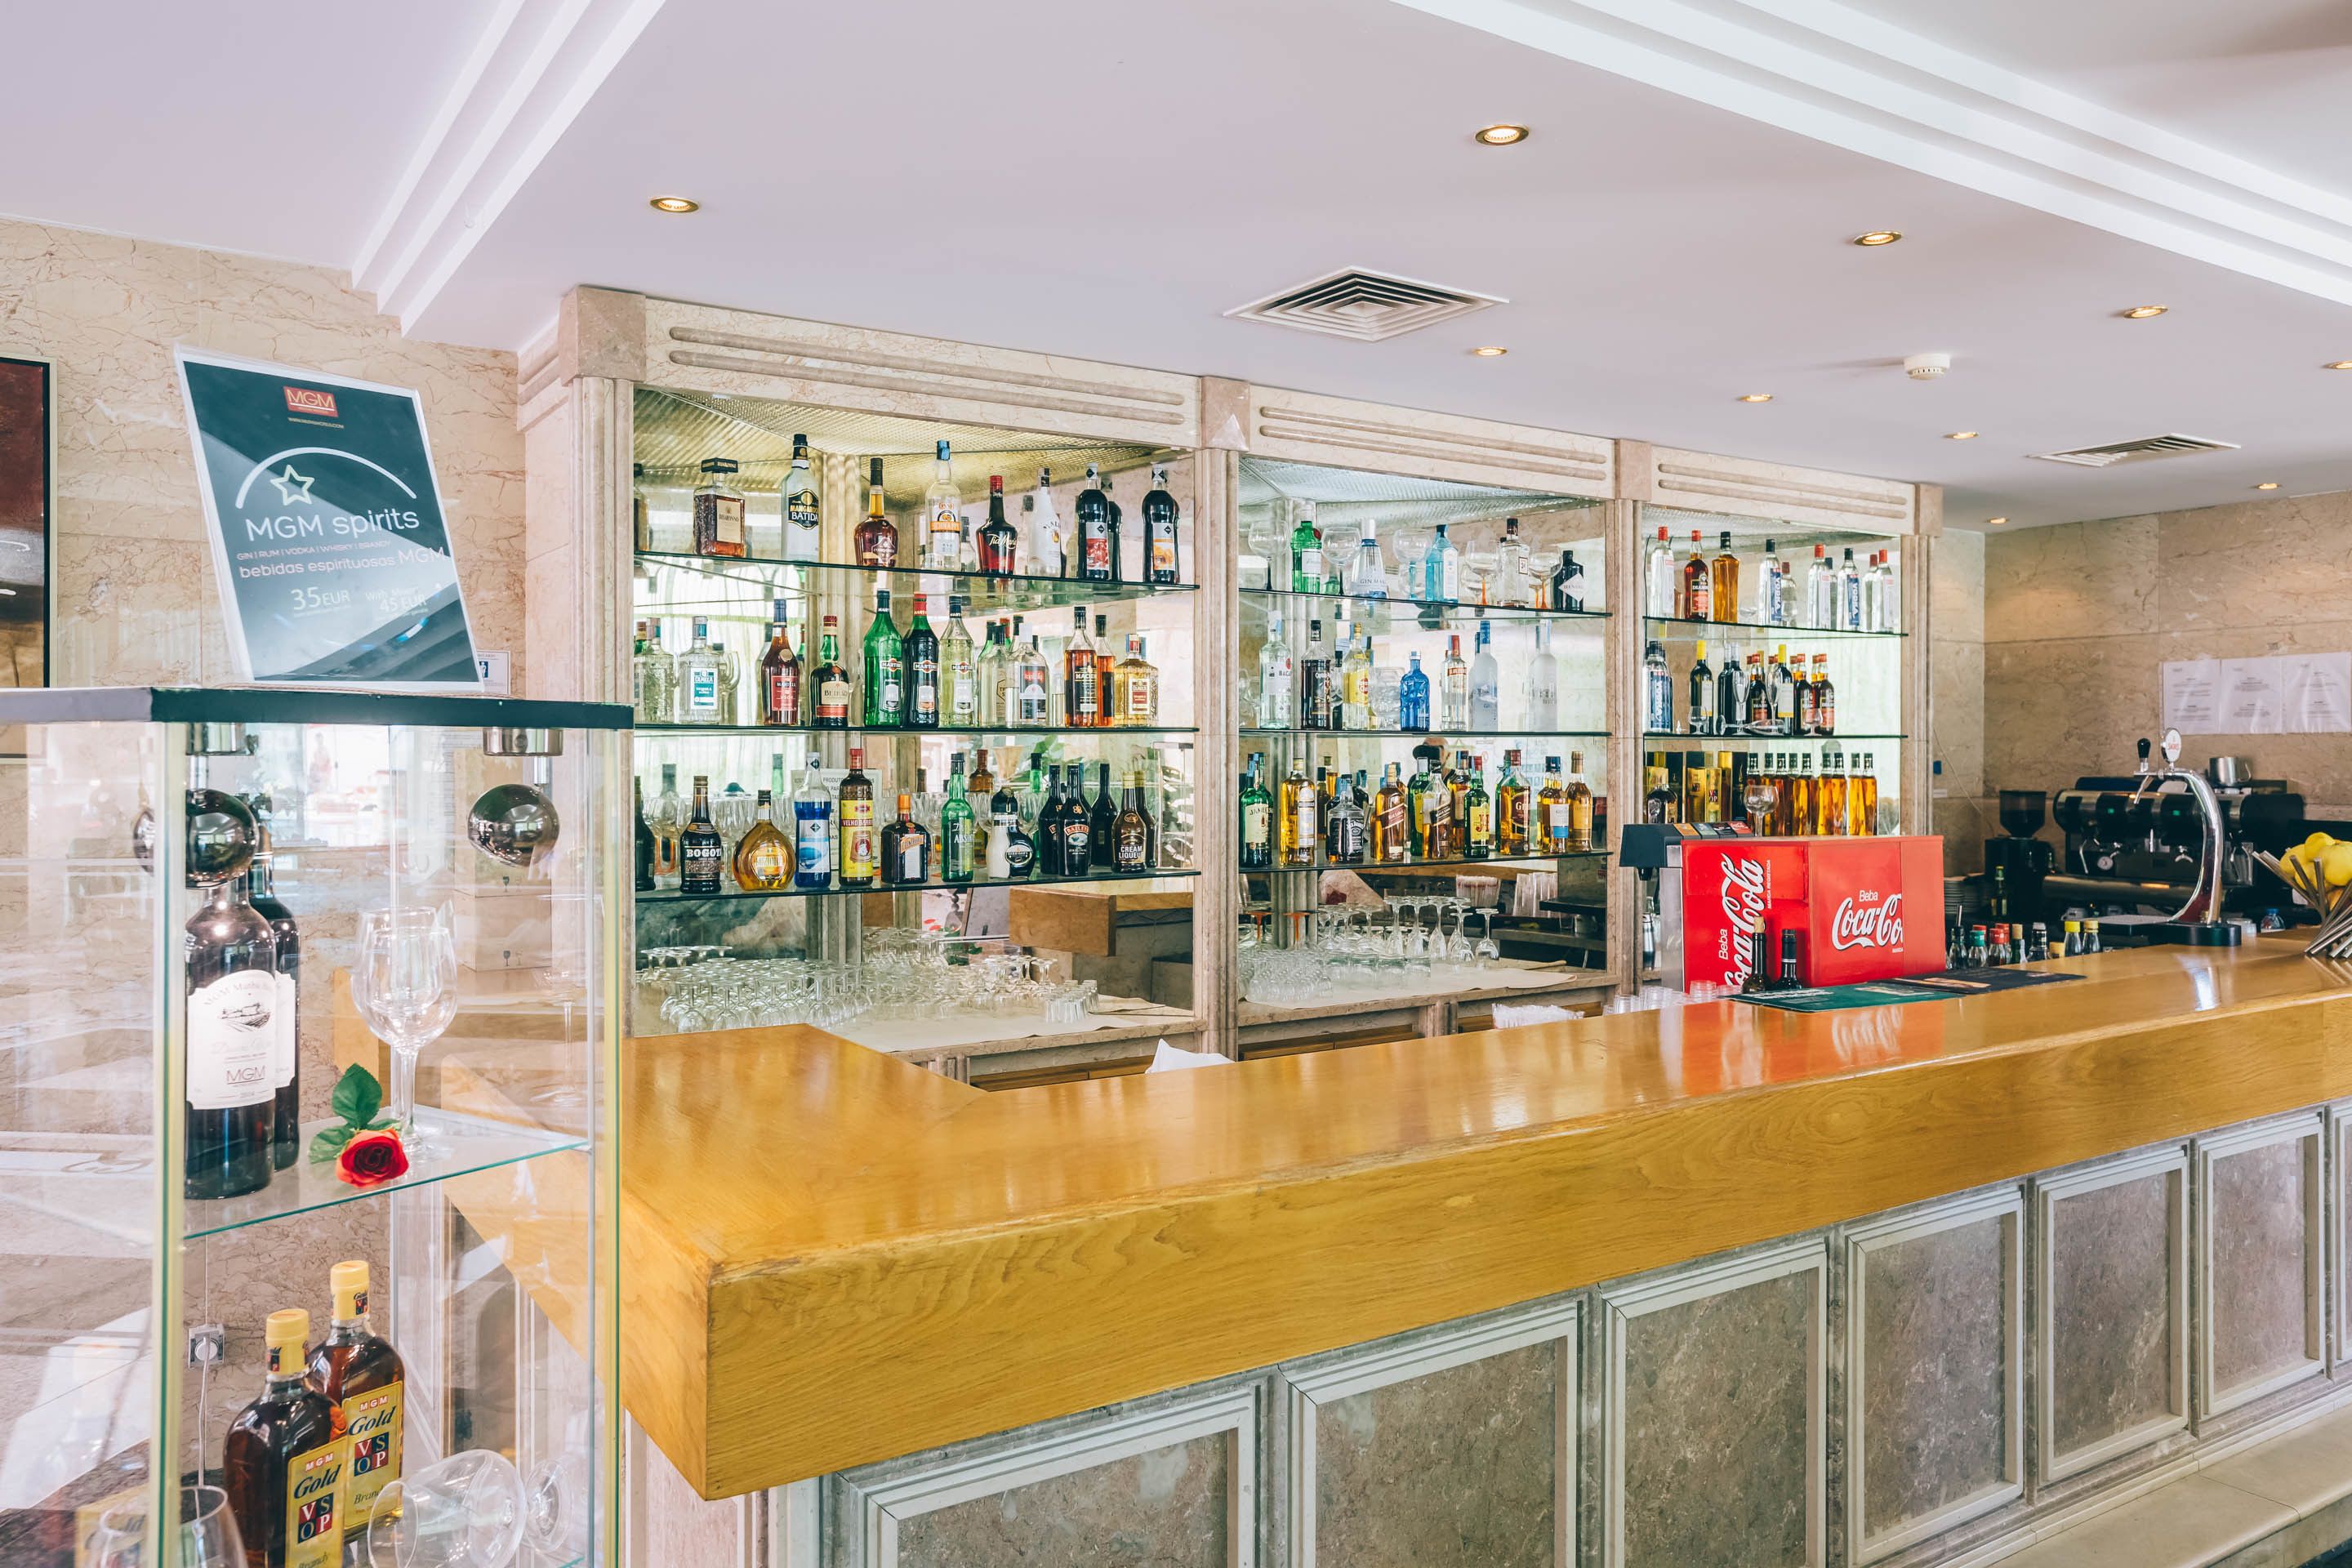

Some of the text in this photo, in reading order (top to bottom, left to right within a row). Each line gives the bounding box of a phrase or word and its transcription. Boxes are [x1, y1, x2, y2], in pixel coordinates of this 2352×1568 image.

[286, 389, 335, 408] MGM
[245, 507, 421, 541] MGM spirits
[238, 546, 447, 578] bebidas espirituosas MGM
[1859, 889, 1879, 902] Beba
[1718, 928, 1729, 960] Beba
[226, 1065, 266, 1084] MGM
[359, 1395, 389, 1413] MGM
[348, 1405, 397, 1437] Gold
[305, 1452, 334, 1472] MGM
[294, 1463, 342, 1499] Gold
